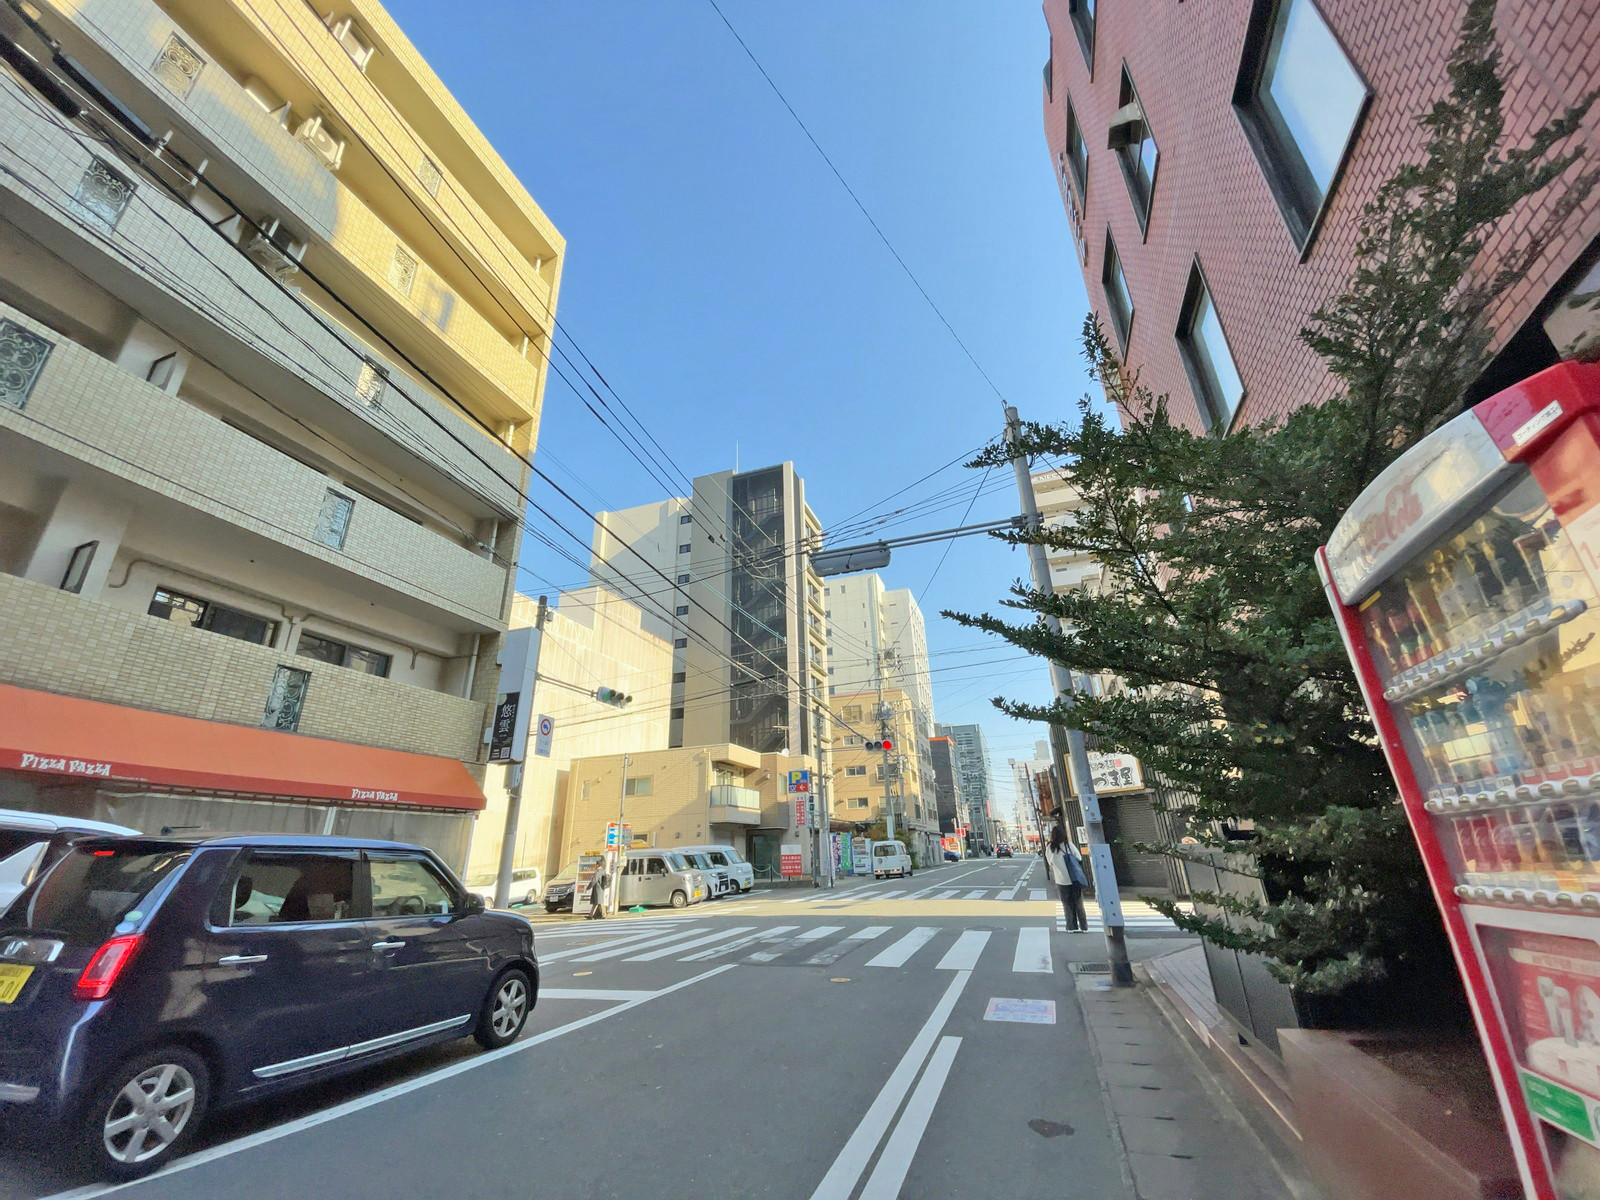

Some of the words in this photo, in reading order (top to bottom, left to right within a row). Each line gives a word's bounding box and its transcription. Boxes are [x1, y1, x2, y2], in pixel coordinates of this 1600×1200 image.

[20, 753, 66, 771] PIZZA
[68, 760, 112, 776] PAZZA
[792, 772, 802, 784] P
[351, 788, 375, 800] PIZZA
